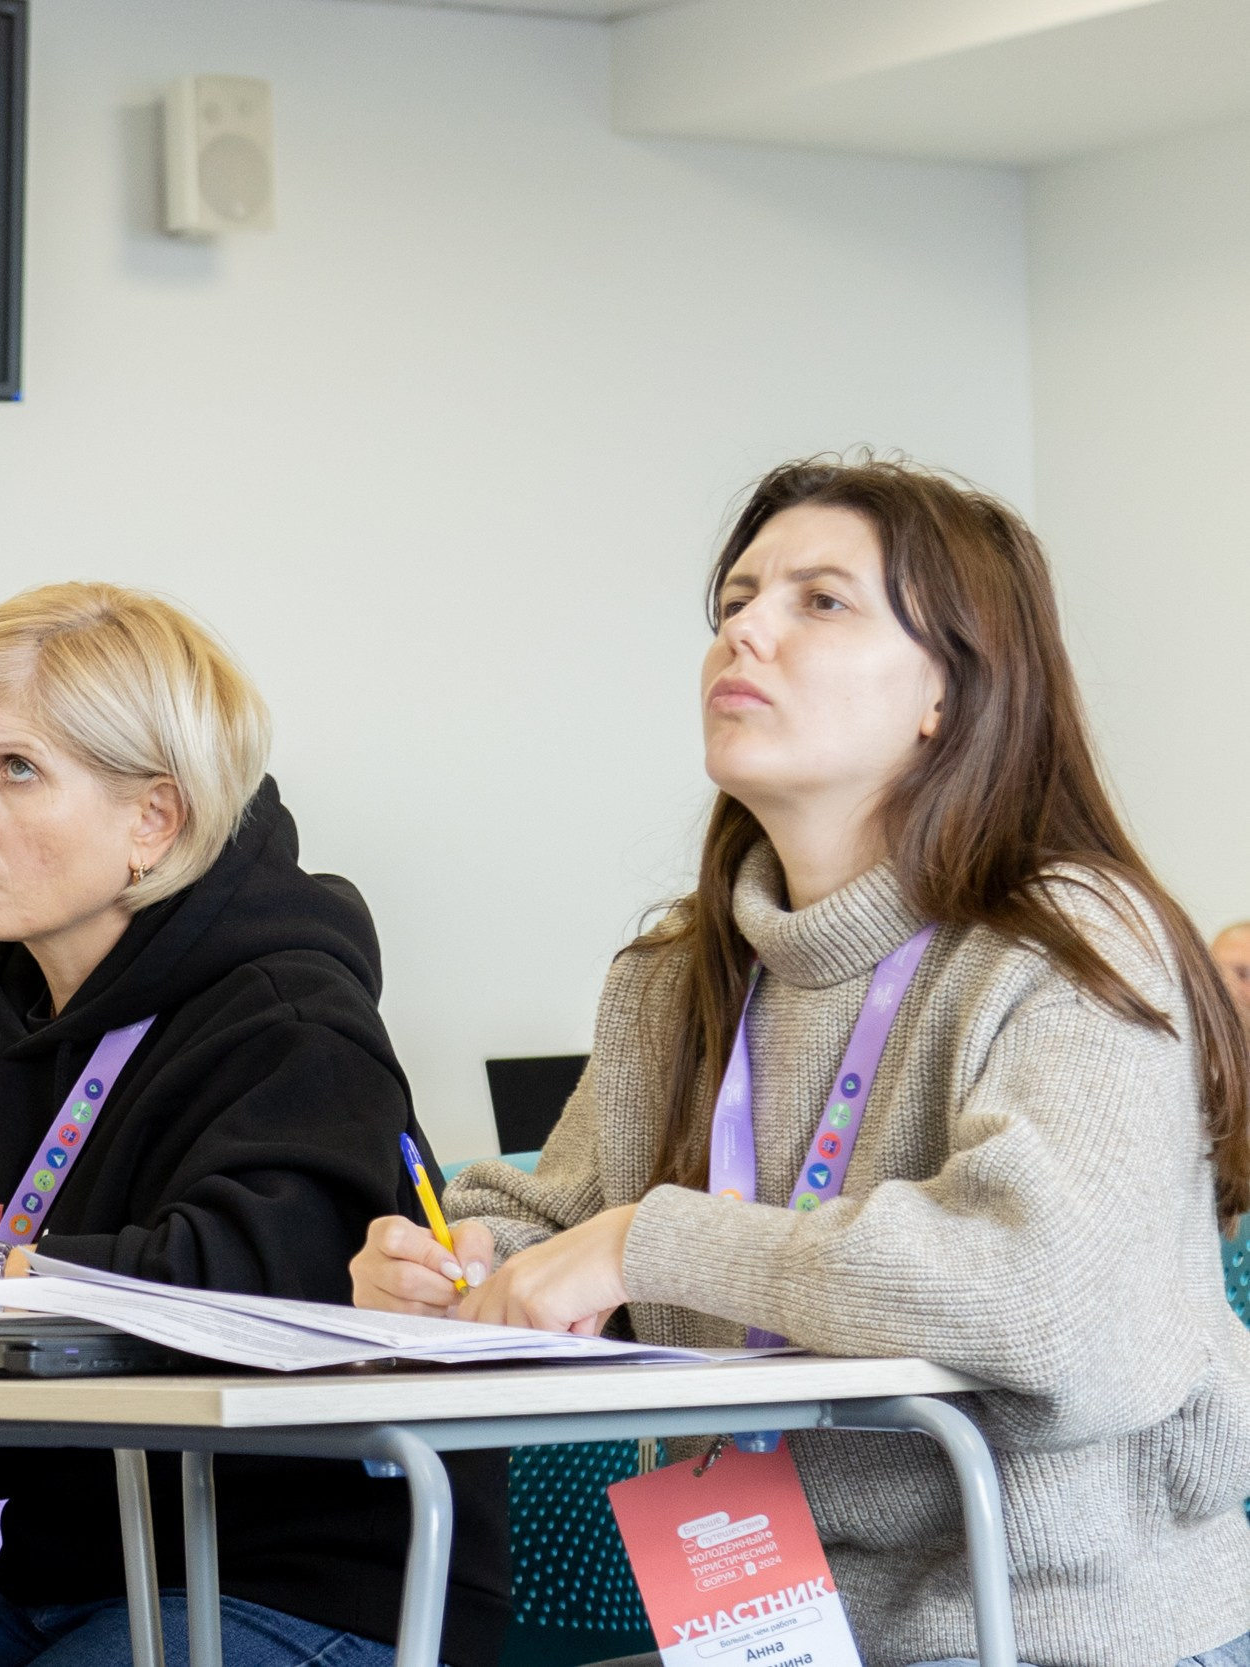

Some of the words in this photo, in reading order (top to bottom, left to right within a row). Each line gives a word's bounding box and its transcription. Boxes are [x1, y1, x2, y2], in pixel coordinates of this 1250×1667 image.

[683, 1515, 726, 1535] Больше,
[701, 1517, 764, 1545] путешествие
[691, 1541, 778, 1577] ТУРИСТИЧЕСКИЙ
[702, 1570, 738, 1588] ФОРУМ
[758, 1555, 782, 1570] 2024
[672, 1576, 827, 1644] УЧАСТНИК
[719, 1632, 754, 1649] Больше,
[753, 1625, 770, 1637] чем
[770, 1617, 798, 1634] работа
[746, 1641, 785, 1663] Анна
